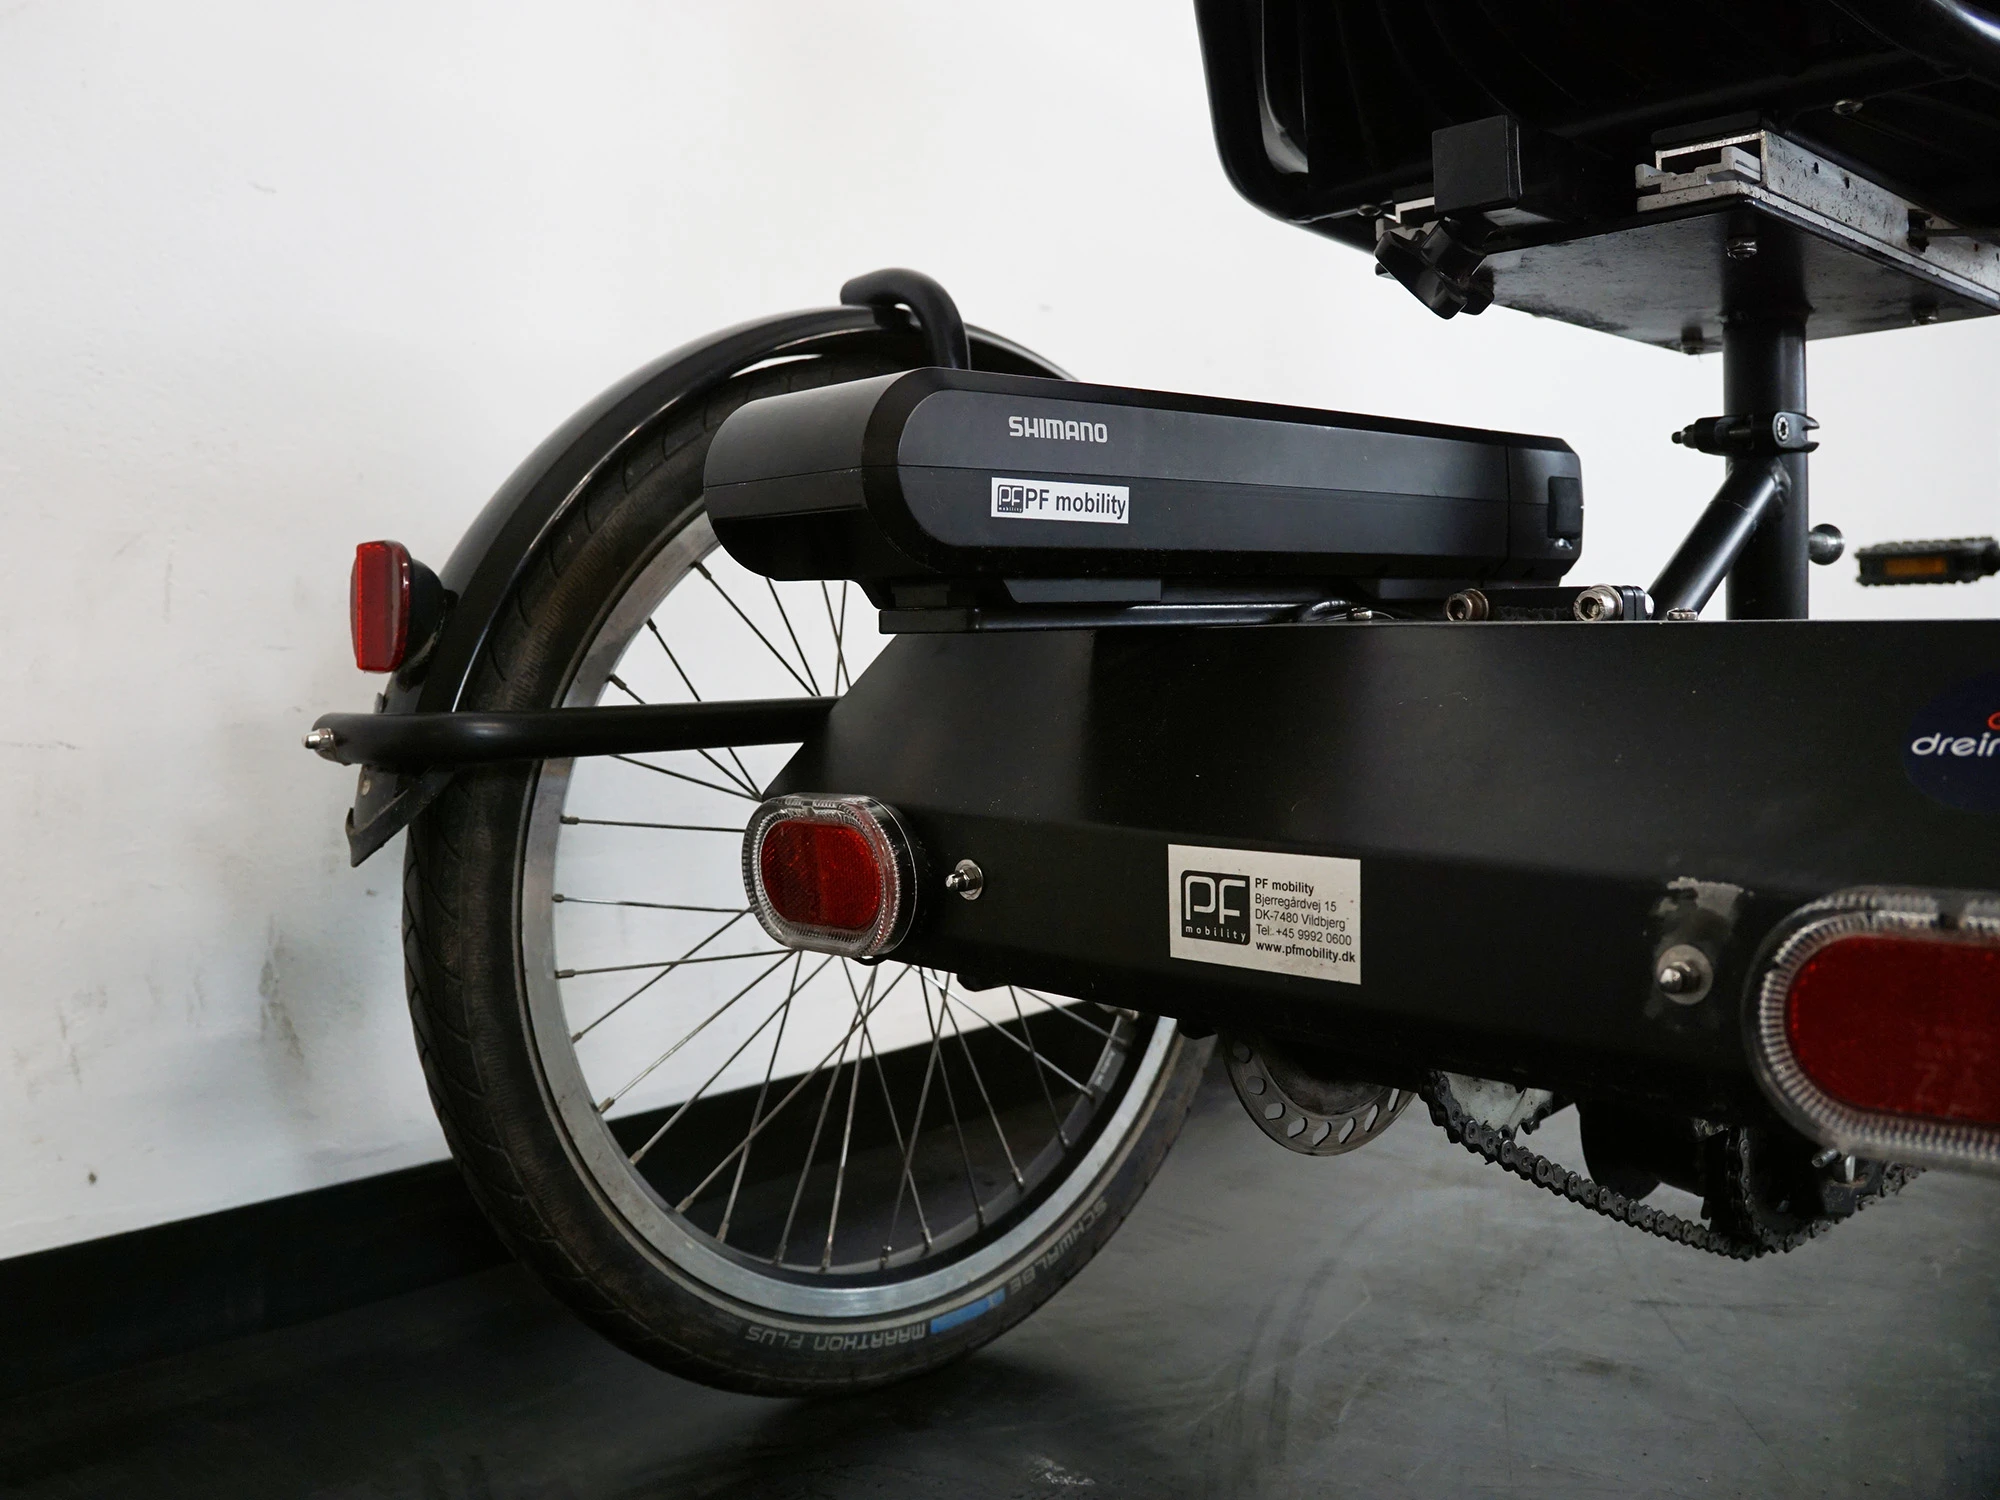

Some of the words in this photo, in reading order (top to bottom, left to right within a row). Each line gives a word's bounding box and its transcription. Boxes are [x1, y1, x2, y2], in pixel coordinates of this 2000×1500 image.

[1008, 415, 1108, 444] SHIMANO
[1025, 488, 1050, 510] PF
[1055, 491, 1127, 520] mobility
[1254, 877, 1268, 890] PF
[1271, 880, 1315, 896] mobility
[1184, 874, 1246, 925] PF
[1255, 893, 1321, 913] Bjerregårdvej
[1325, 900, 1337, 912] 15
[1255, 909, 1298, 924] DK-7480
[1301, 914, 1346, 931] Vildbjerg
[1185, 925, 1247, 942] mobility
[1276, 928, 1295, 940] +45
[1297, 929, 1323, 943] 9992
[1325, 932, 1352, 946] 0600
[1255, 940, 1356, 963] www.pfmobility.dk
[1009, 1196, 1108, 1296] SCHWALBE
[744, 1325, 804, 1349] PLUS
[813, 1323, 926, 1350] MARATHON
